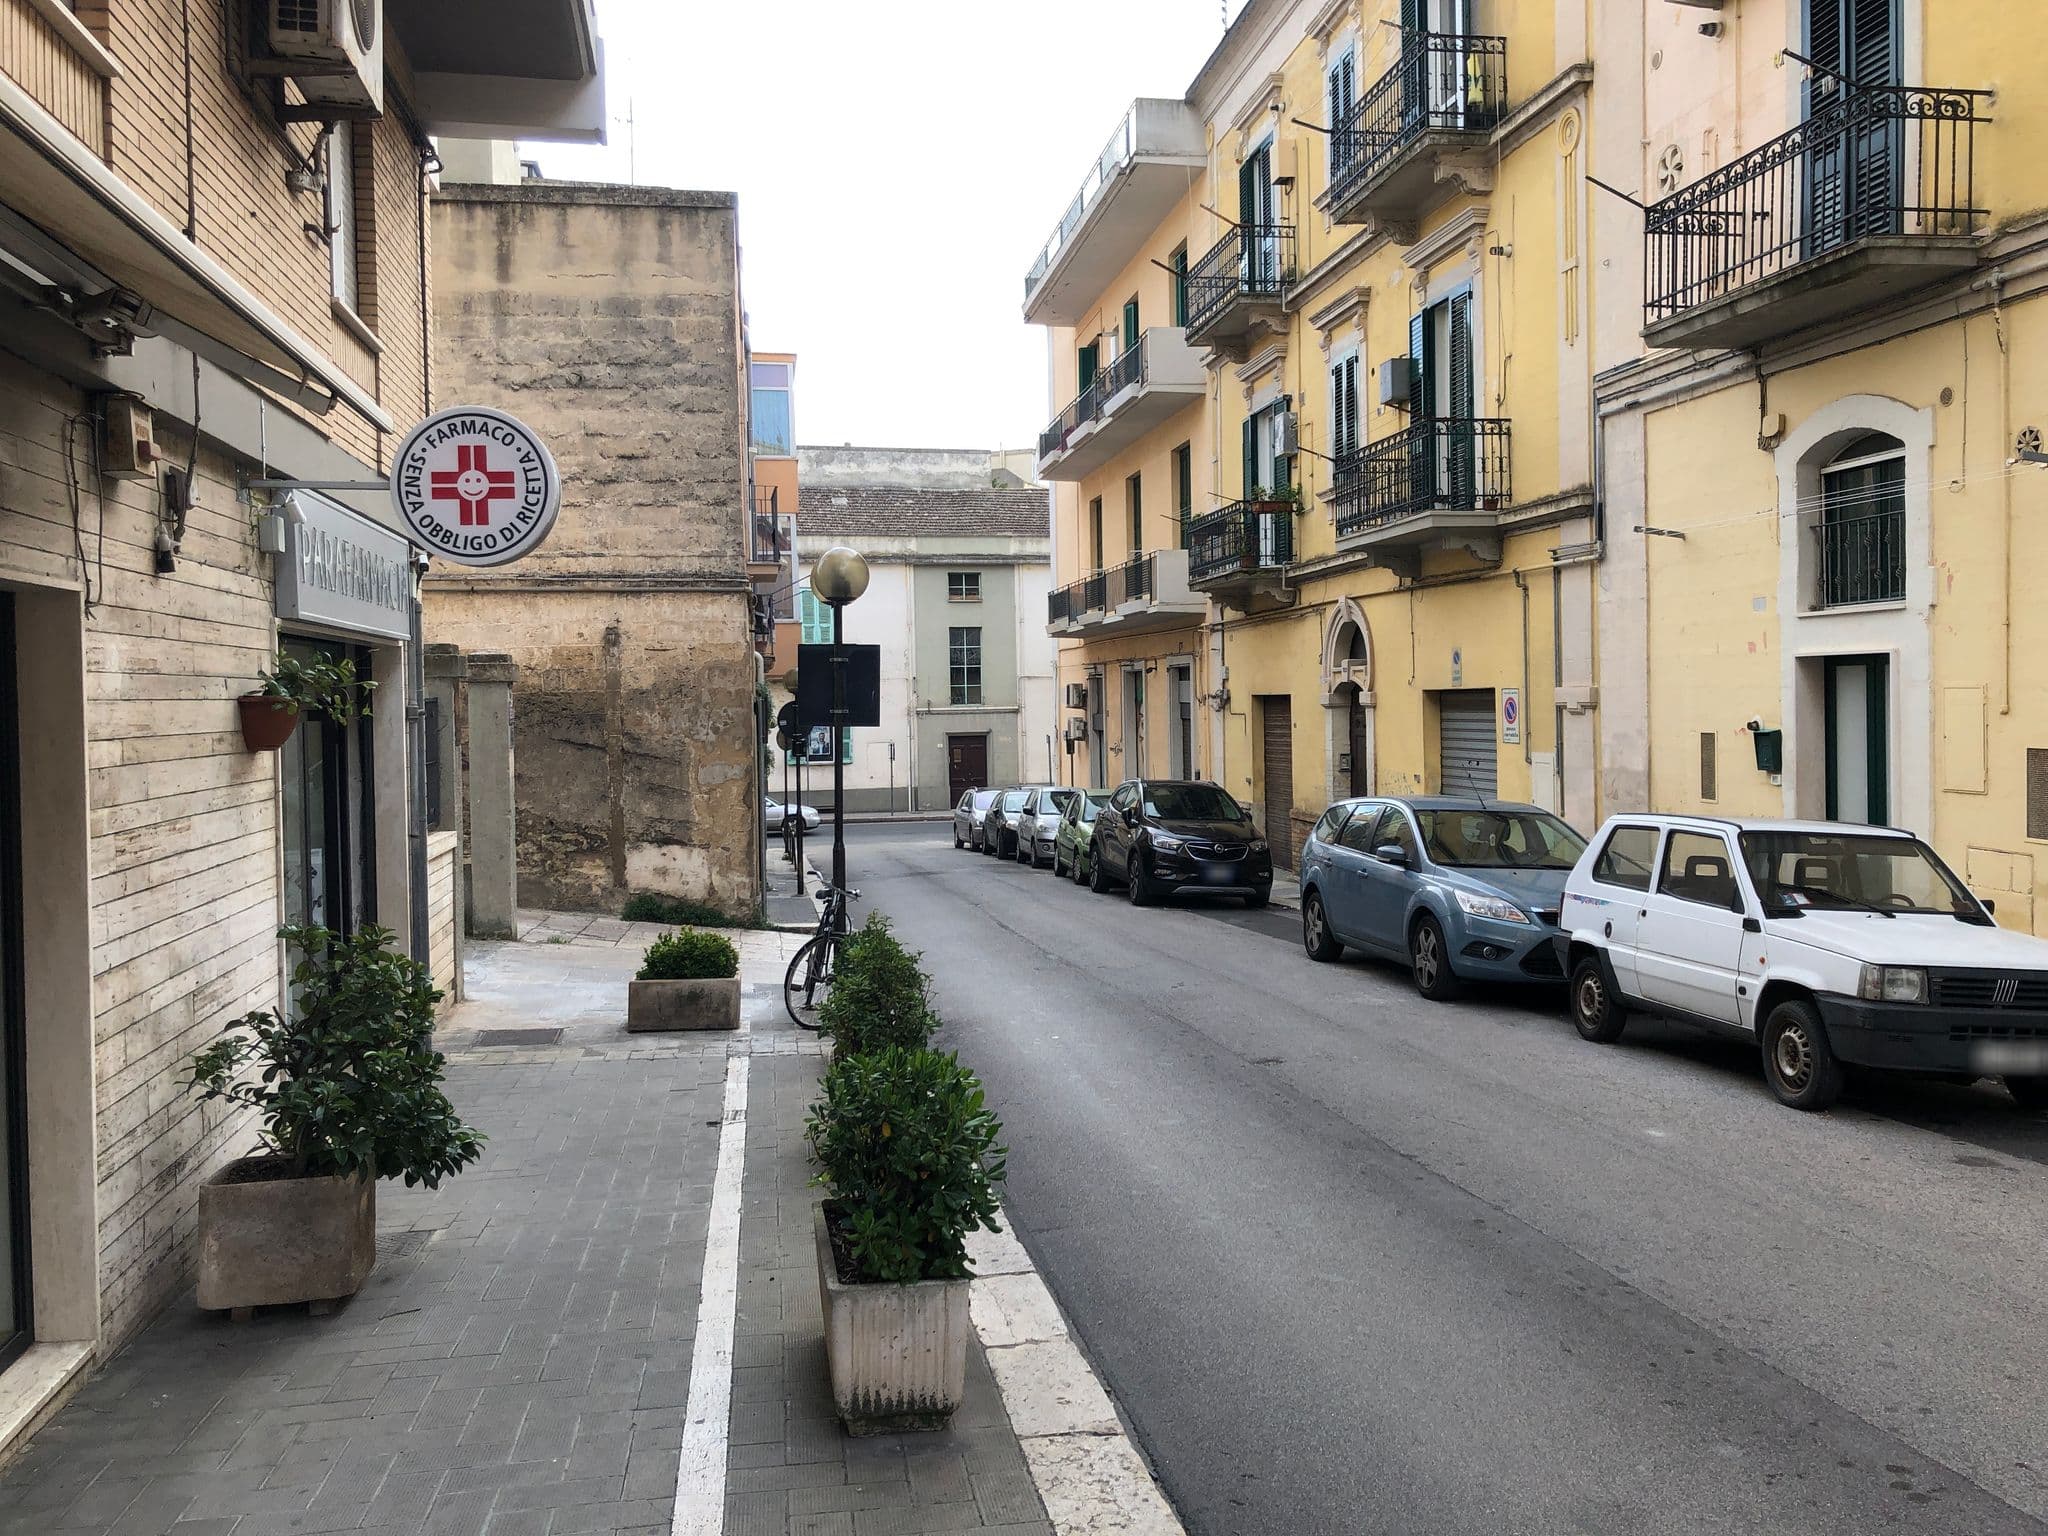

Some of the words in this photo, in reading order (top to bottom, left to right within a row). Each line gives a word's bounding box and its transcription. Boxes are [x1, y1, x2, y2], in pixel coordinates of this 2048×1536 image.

[425, 420, 515, 449] FARMACO
[404, 453, 426, 514] SENZA
[419, 514, 497, 550] OBBLIGO
[499, 522, 521, 543] DI
[516, 451, 541, 525] RICETTA
[299, 522, 409, 613] PARAFARMACIA
